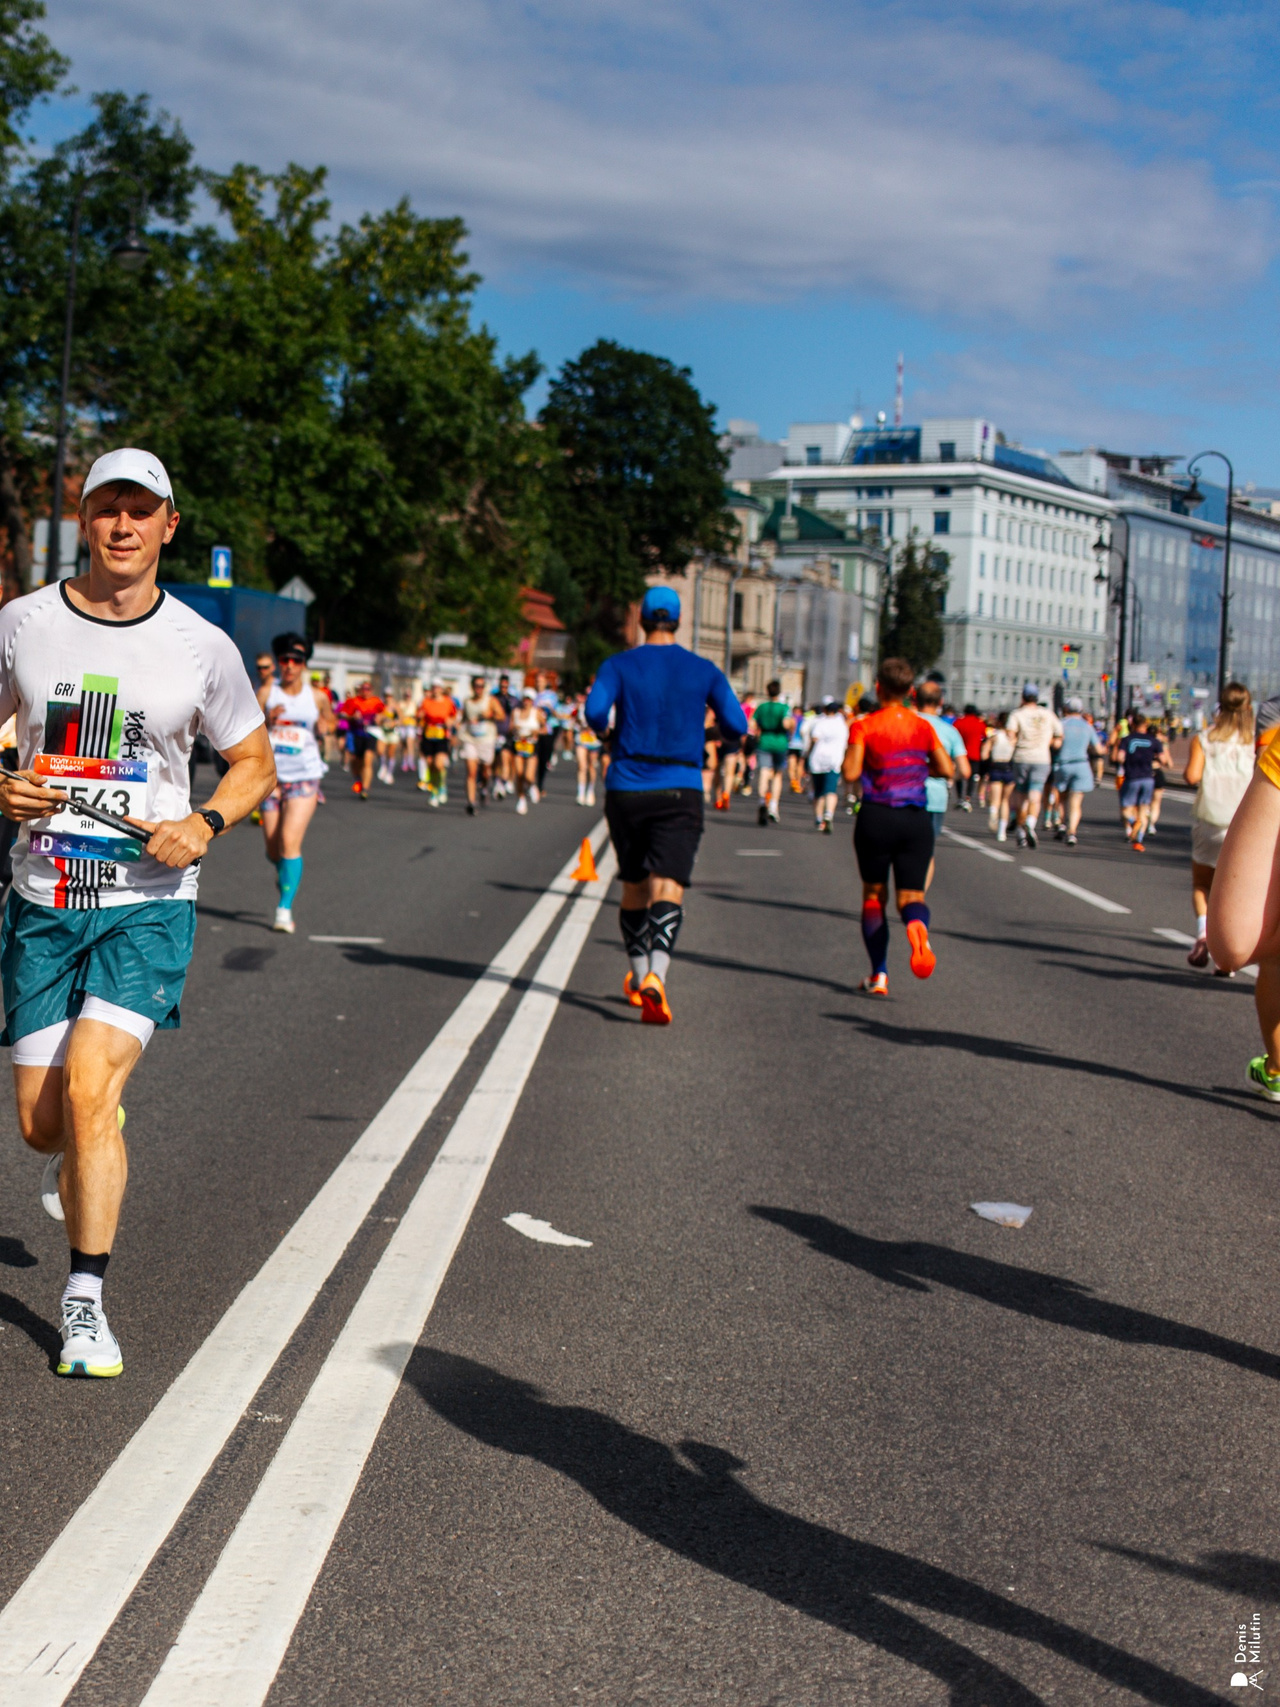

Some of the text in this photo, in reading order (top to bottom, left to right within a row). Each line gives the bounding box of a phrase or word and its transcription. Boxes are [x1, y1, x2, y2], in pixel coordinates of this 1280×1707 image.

[54, 682, 76, 697] GRi
[50, 757, 70, 765] ПОЛУ
[50, 763, 85, 772] МАРАФОН
[100, 765, 116, 776] 21,1
[80, 820, 95, 830] ЯН
[40, 834, 54, 852] D
